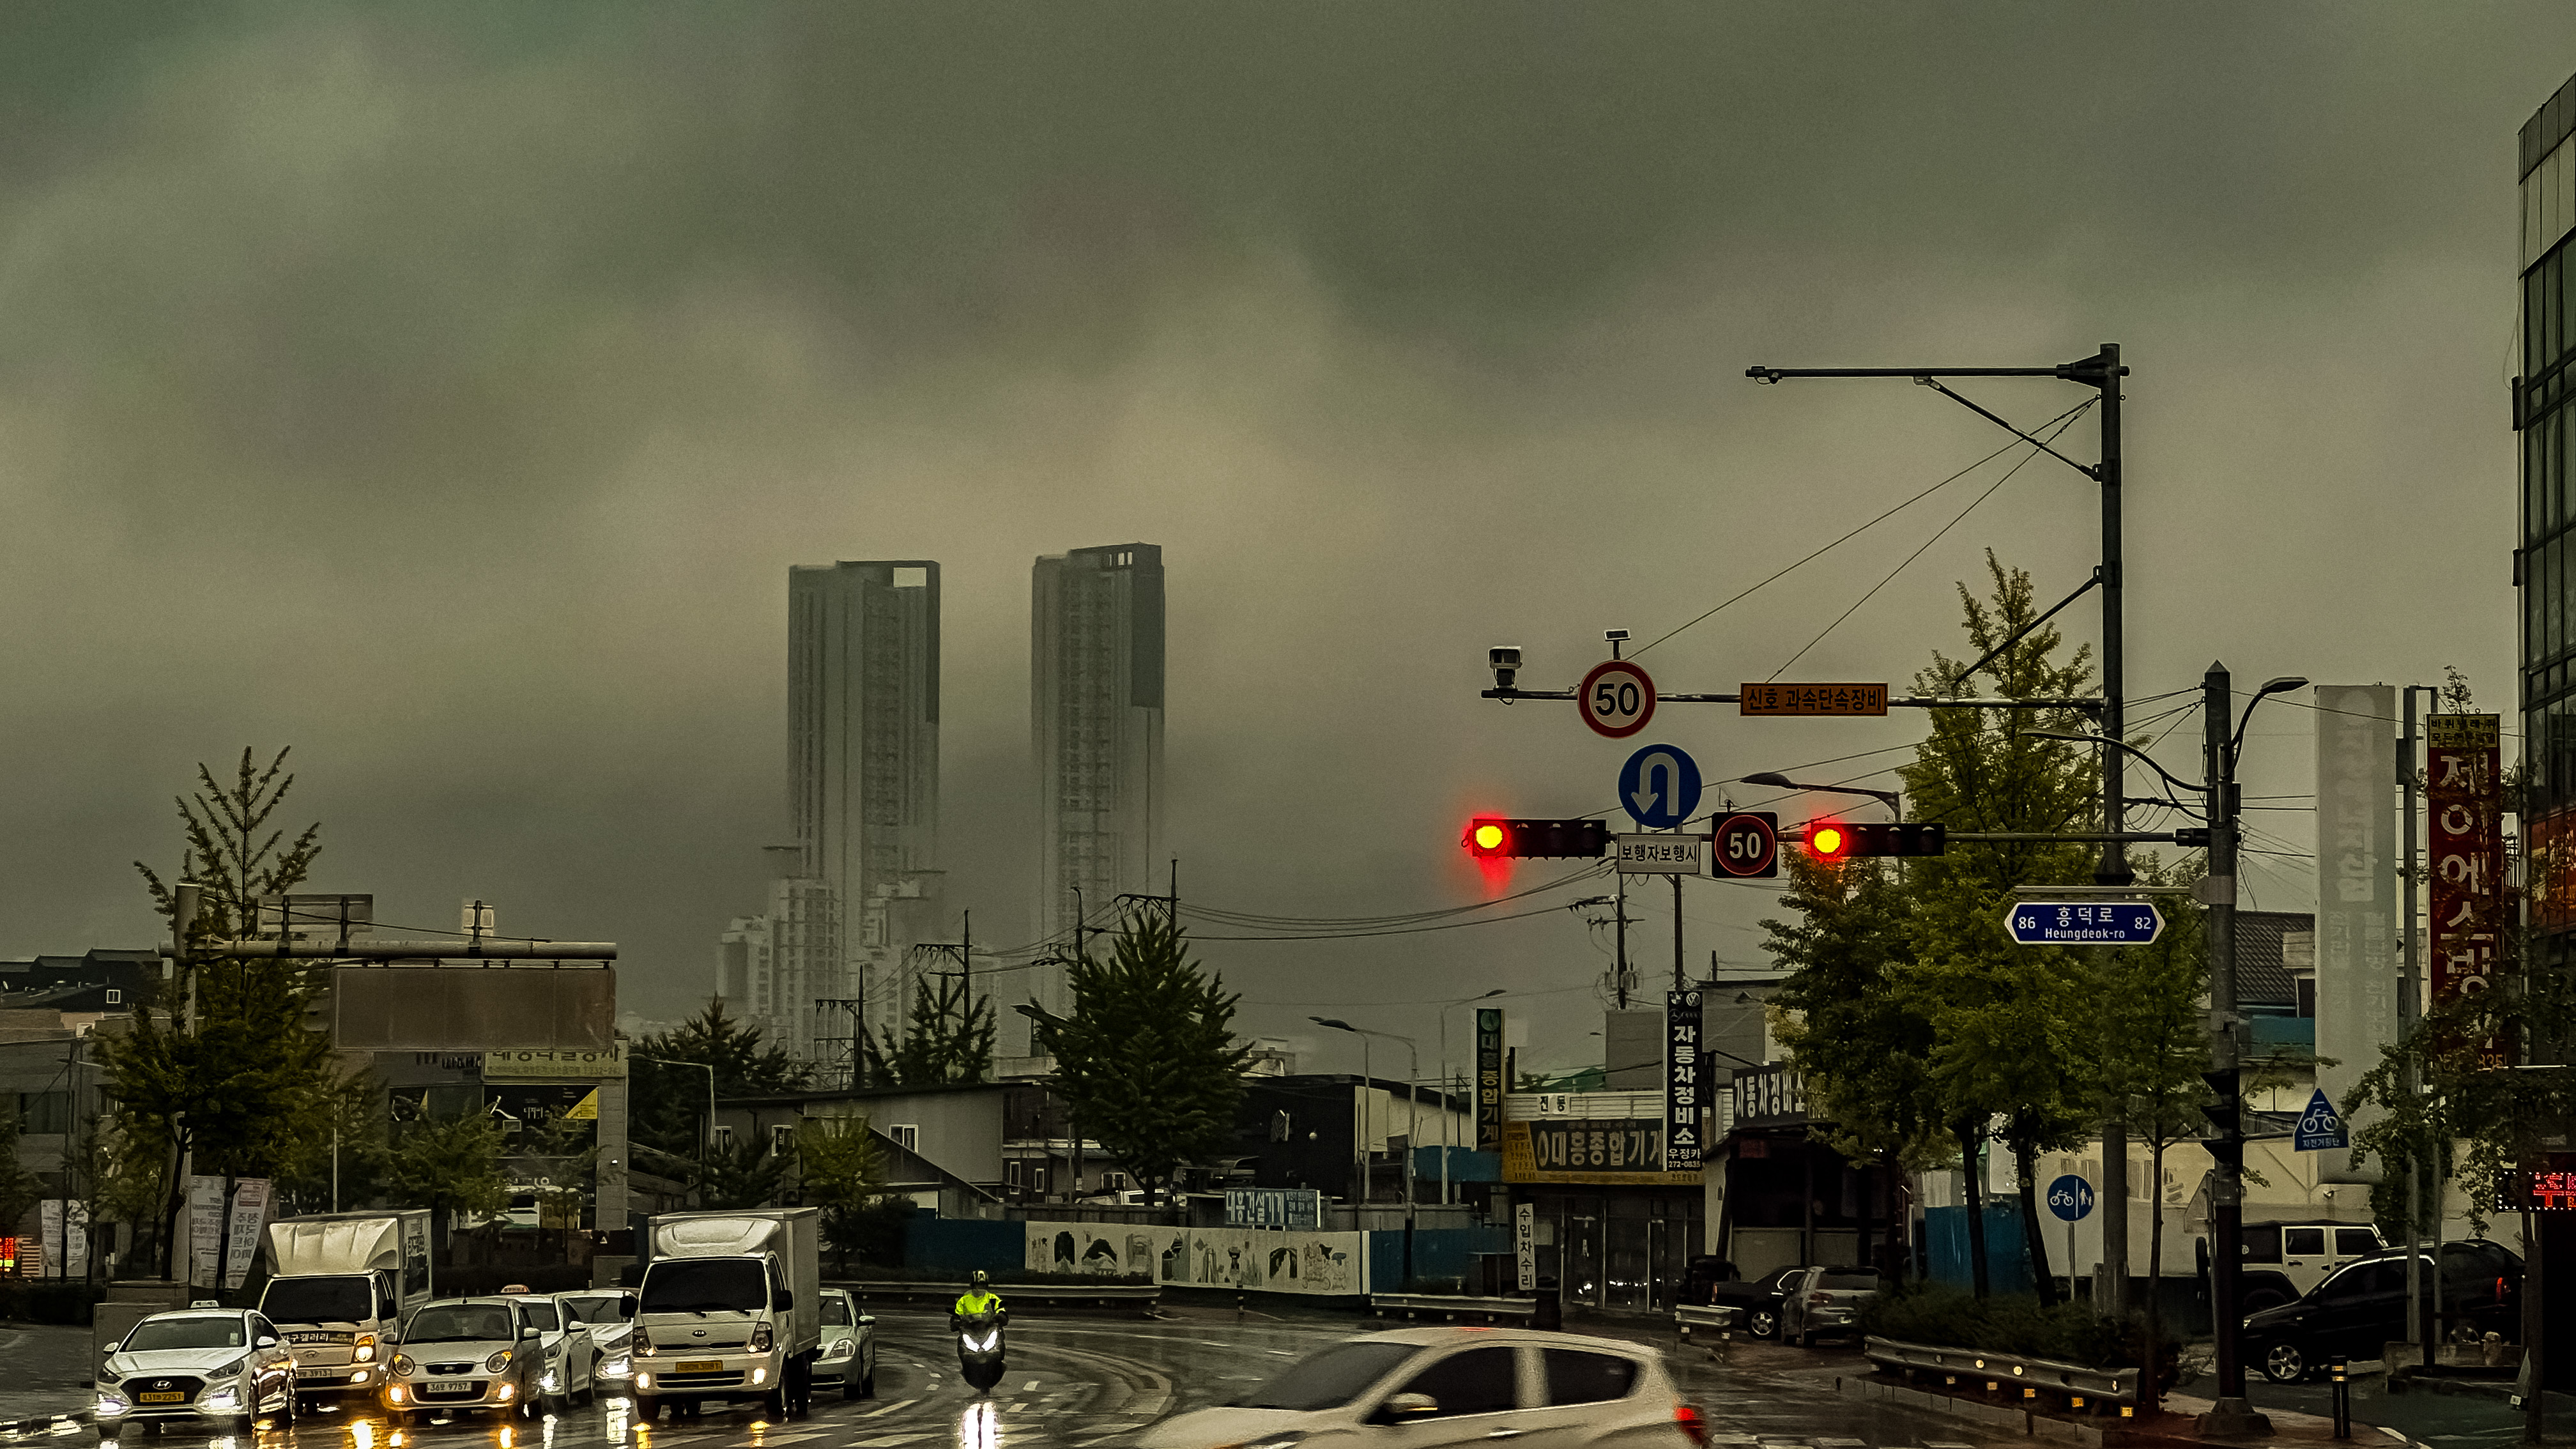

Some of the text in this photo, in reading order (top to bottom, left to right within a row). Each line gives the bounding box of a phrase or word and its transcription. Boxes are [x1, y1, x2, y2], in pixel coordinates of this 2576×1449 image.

[1595, 682, 1638, 717] 50
[1747, 689, 1882, 711] 신호 과속단속장비
[1620, 842, 1698, 863] 보행자보행시
[1728, 831, 1761, 860] 50
[2018, 916, 2036, 930] 86
[2056, 906, 2114, 927] 흥덕로
[2134, 917, 2151, 930] 82
[2044, 928, 2126, 940] Heungdeok-ro
[1674, 1025, 1696, 1145] 자동차정비소
[1667, 1148, 1701, 1160] 우정카
[1519, 1207, 1533, 1288] 수입차수리
[448, 1382, 468, 1391] 9757
